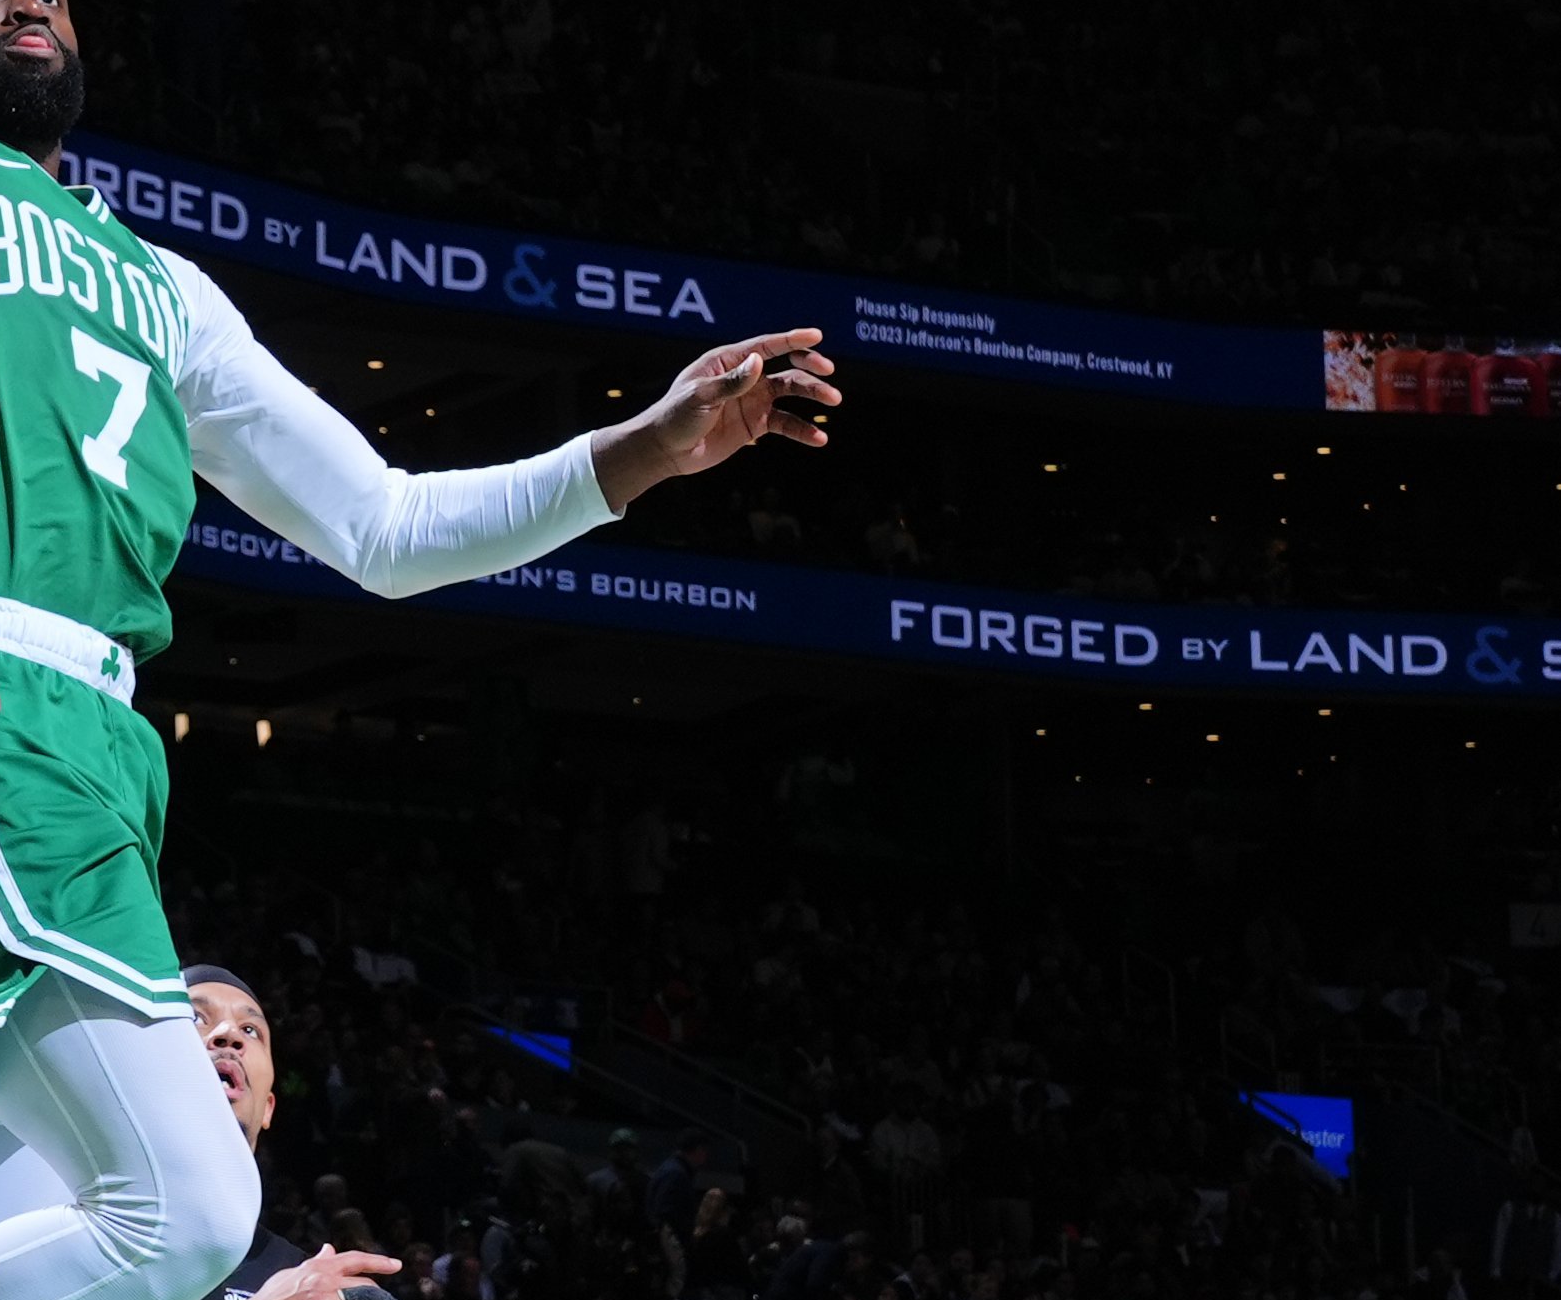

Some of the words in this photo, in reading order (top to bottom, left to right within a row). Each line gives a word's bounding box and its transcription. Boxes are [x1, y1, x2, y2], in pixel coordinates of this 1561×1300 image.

[60, 151, 249, 241] RGED
[264, 217, 302, 247] BY
[315, 220, 488, 292] LAND
[502, 242, 558, 309] &
[575, 264, 715, 324] SEA
[855, 296, 897, 320] Please
[899, 301, 919, 325] Sip
[922, 304, 996, 335] Responsibly
[855, 320, 902, 343] ©2023
[905, 327, 971, 354] Jefferson's
[974, 337, 1024, 360] Bourbon
[1156, 360, 1174, 380] KY
[70, 326, 152, 491] 7
[185, 522, 325, 567] ISCOVE
[590, 571, 757, 612] BOURBON
[890, 599, 1159, 666] FORGED
[1182, 637, 1229, 662] BY
[1250, 630, 1448, 676] LAND
[1465, 626, 1522, 685] &
